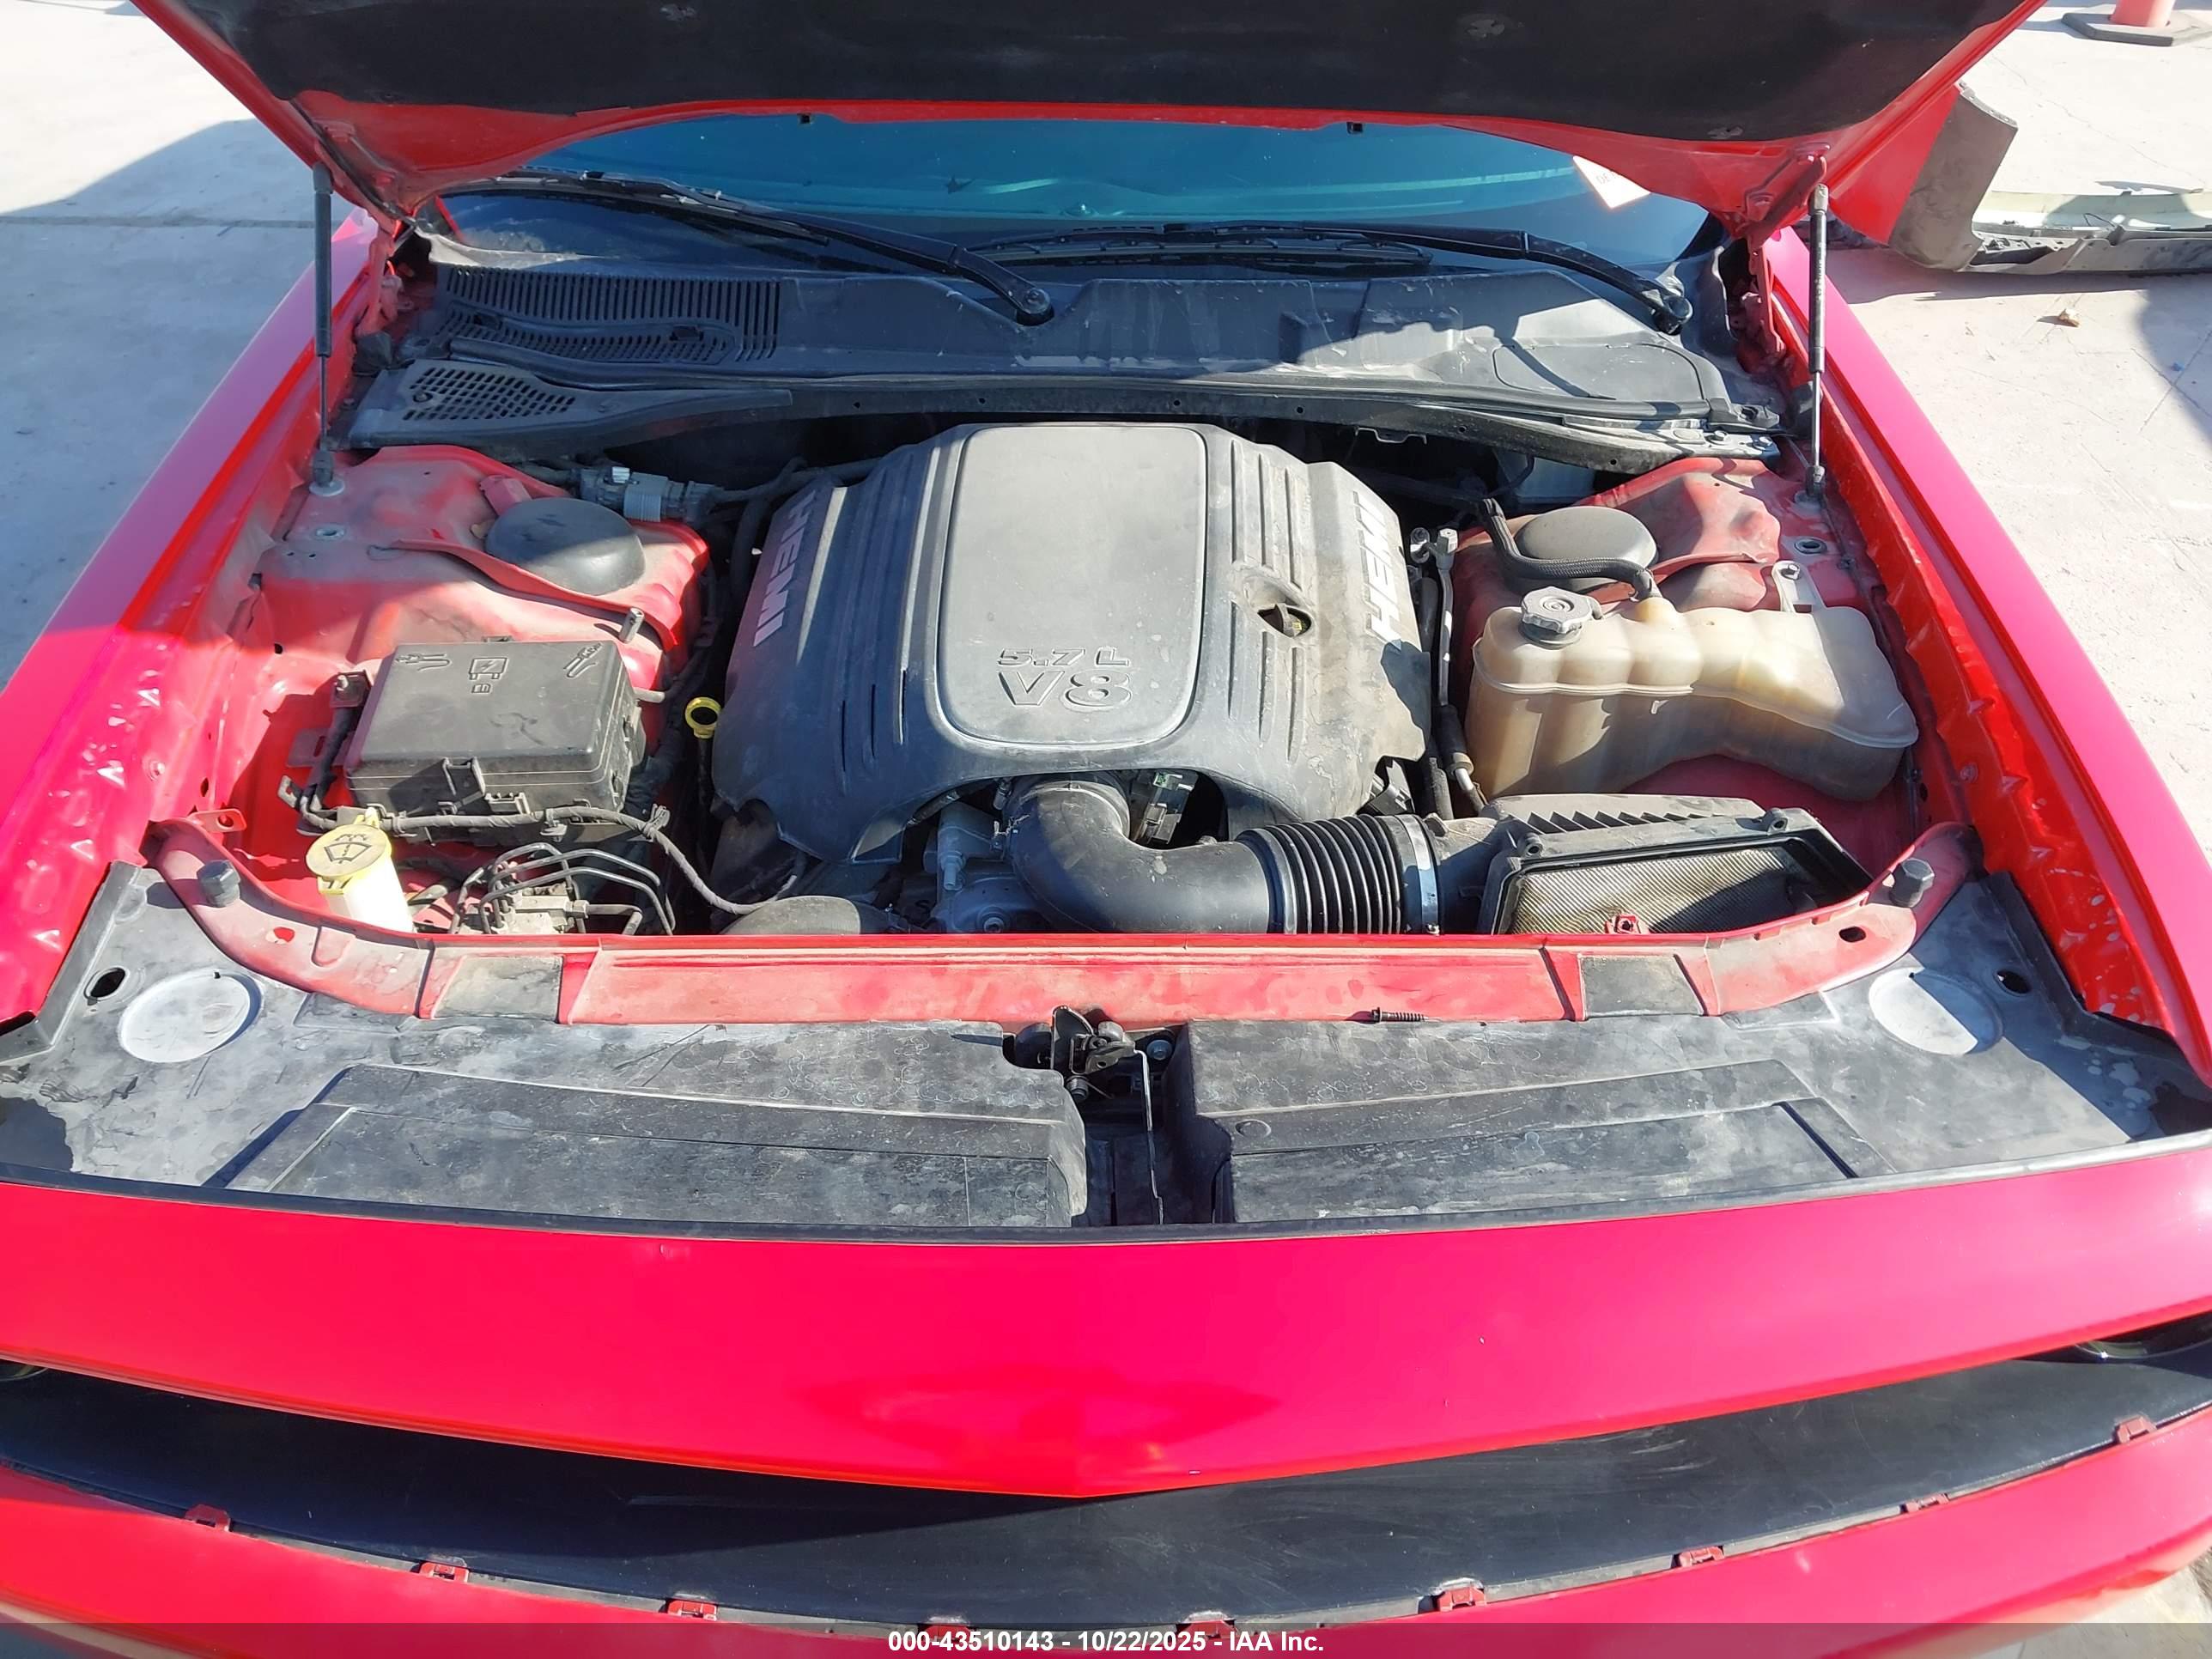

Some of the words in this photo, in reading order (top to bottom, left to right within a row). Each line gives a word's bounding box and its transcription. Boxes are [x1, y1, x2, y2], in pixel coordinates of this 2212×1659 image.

[753, 489, 817, 647] HEMI
[1352, 490, 1402, 643] HEMI
[996, 669, 1133, 712] V8
